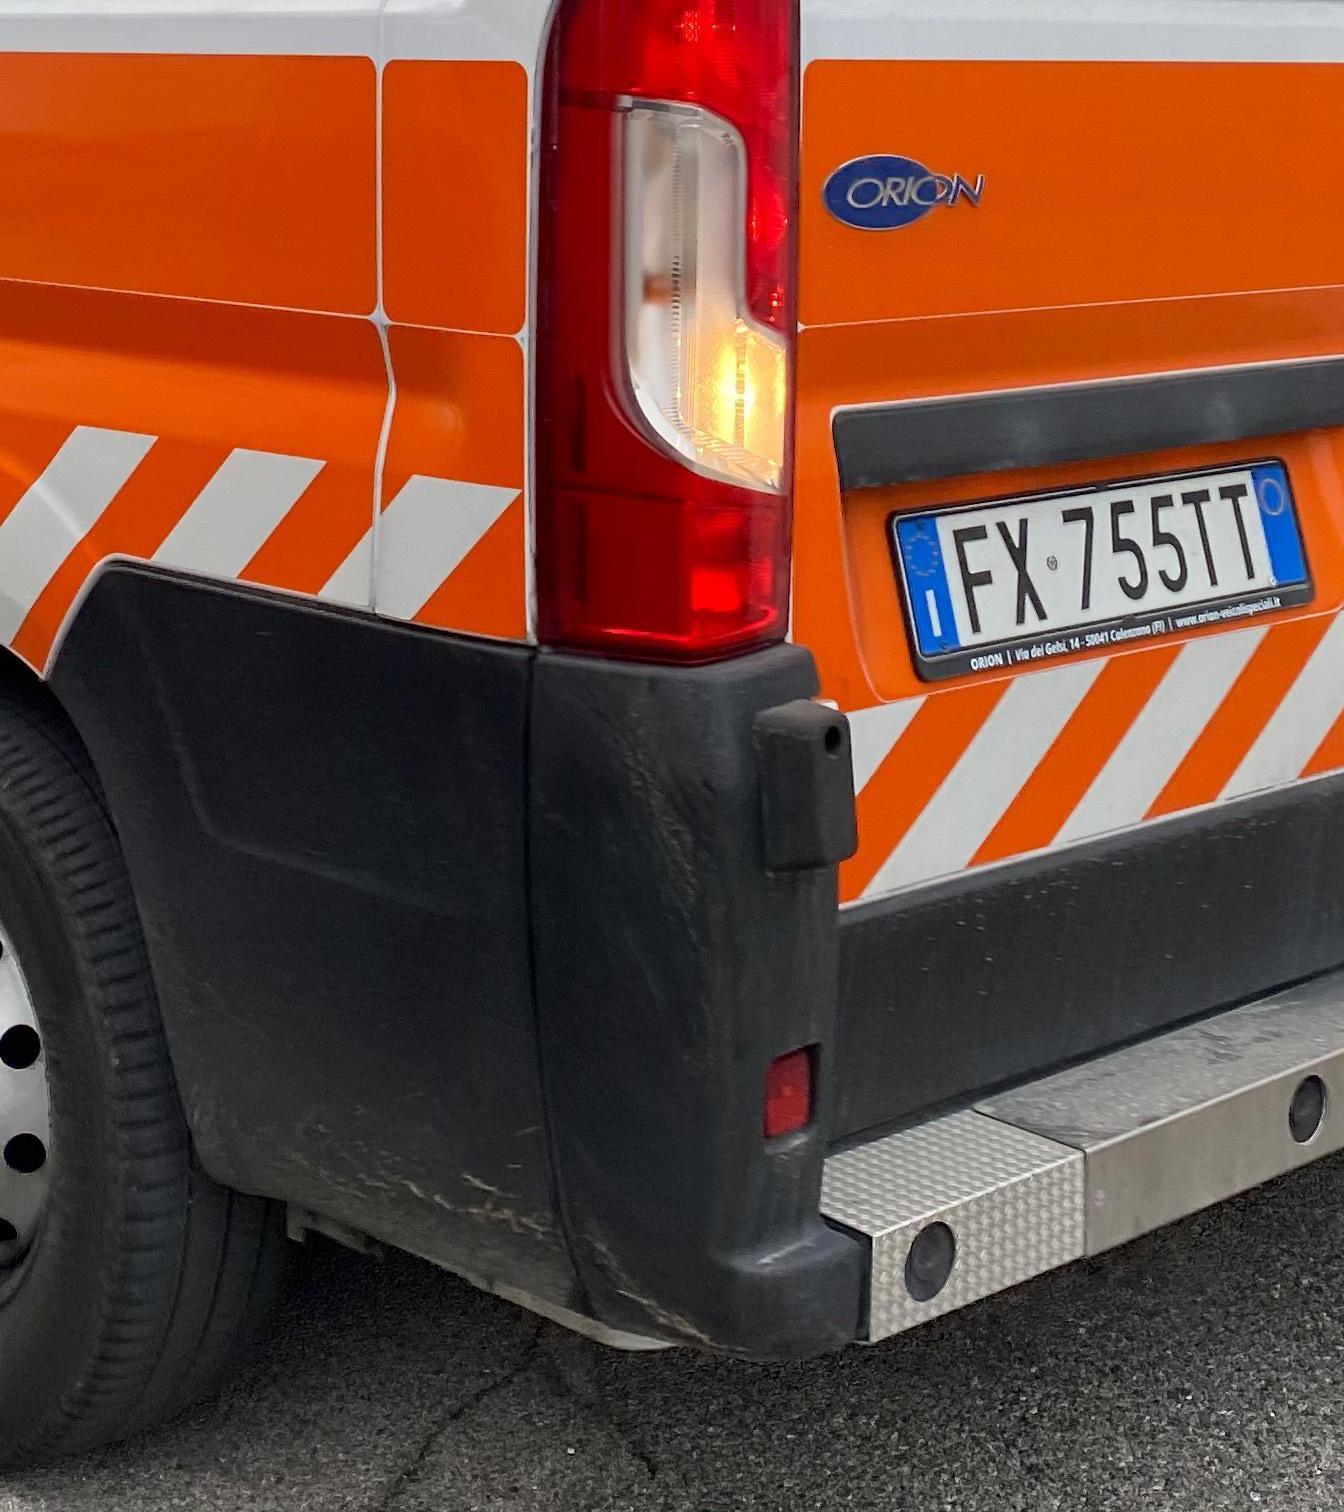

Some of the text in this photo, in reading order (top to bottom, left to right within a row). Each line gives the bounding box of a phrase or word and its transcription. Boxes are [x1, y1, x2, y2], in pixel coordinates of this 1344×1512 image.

[846, 172, 985, 208] ORION
[953, 484, 1255, 634] FX 755TT
[970, 654, 1003, 670] ORION
[1015, 648, 1030, 661] Via
[1070, 638, 1080, 650] 14
